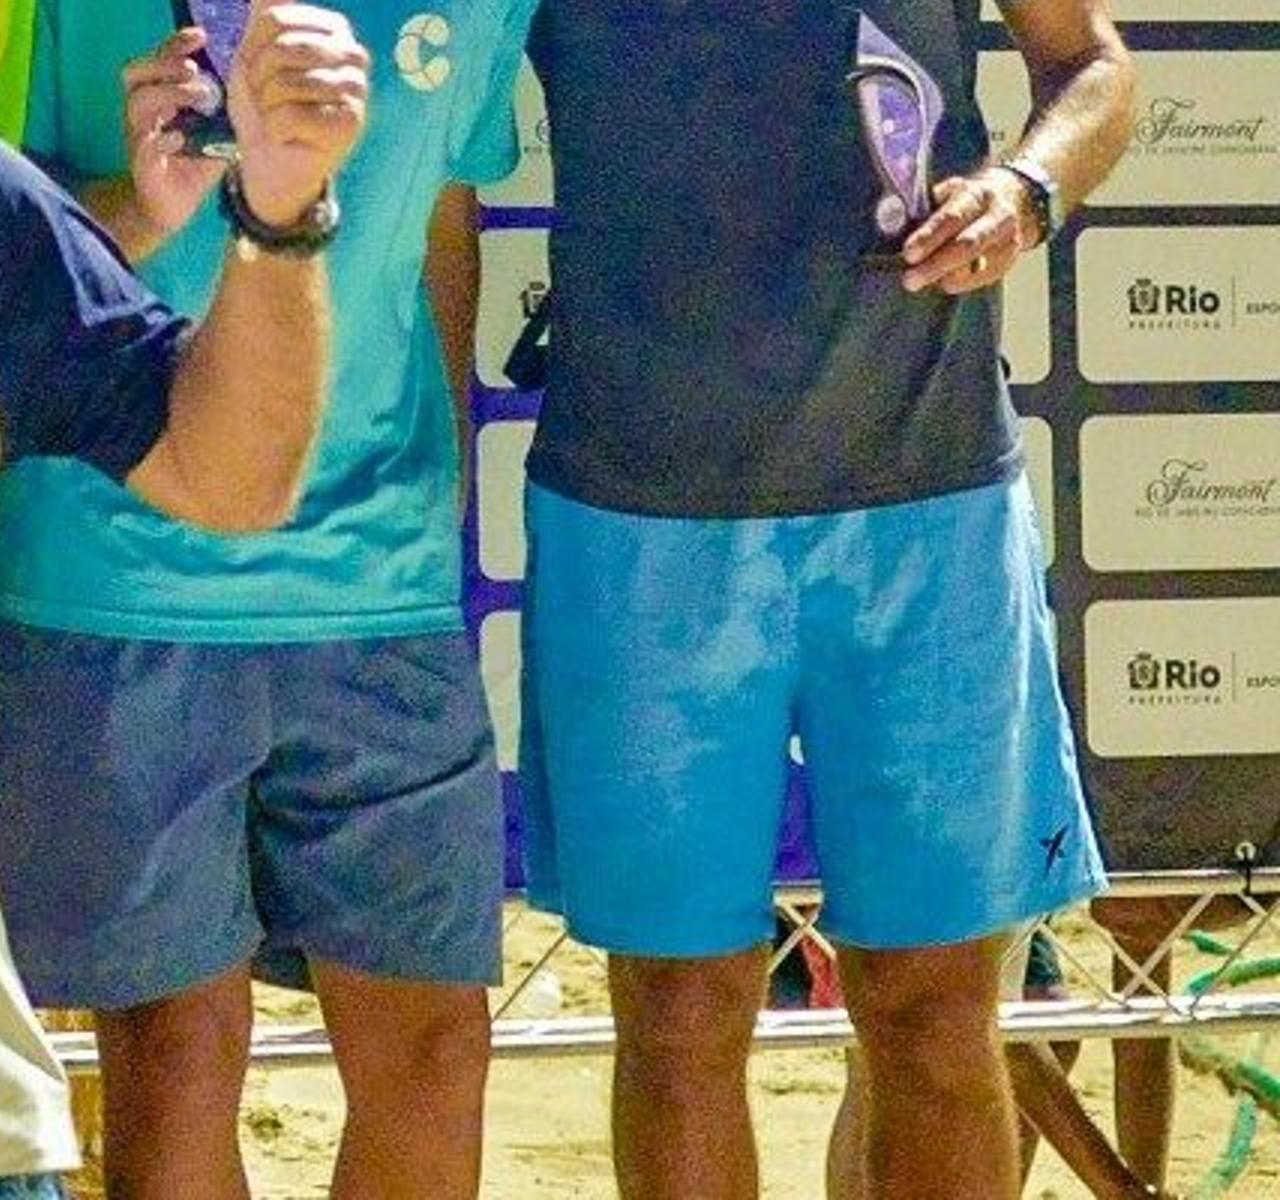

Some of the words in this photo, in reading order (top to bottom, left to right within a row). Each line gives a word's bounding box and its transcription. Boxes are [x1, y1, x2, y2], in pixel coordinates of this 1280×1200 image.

[1136, 98, 1264, 145] Fairmont
[1165, 284, 1221, 315] Rio
[1146, 459, 1277, 508] Fairmont
[1165, 659, 1221, 690] Rio
